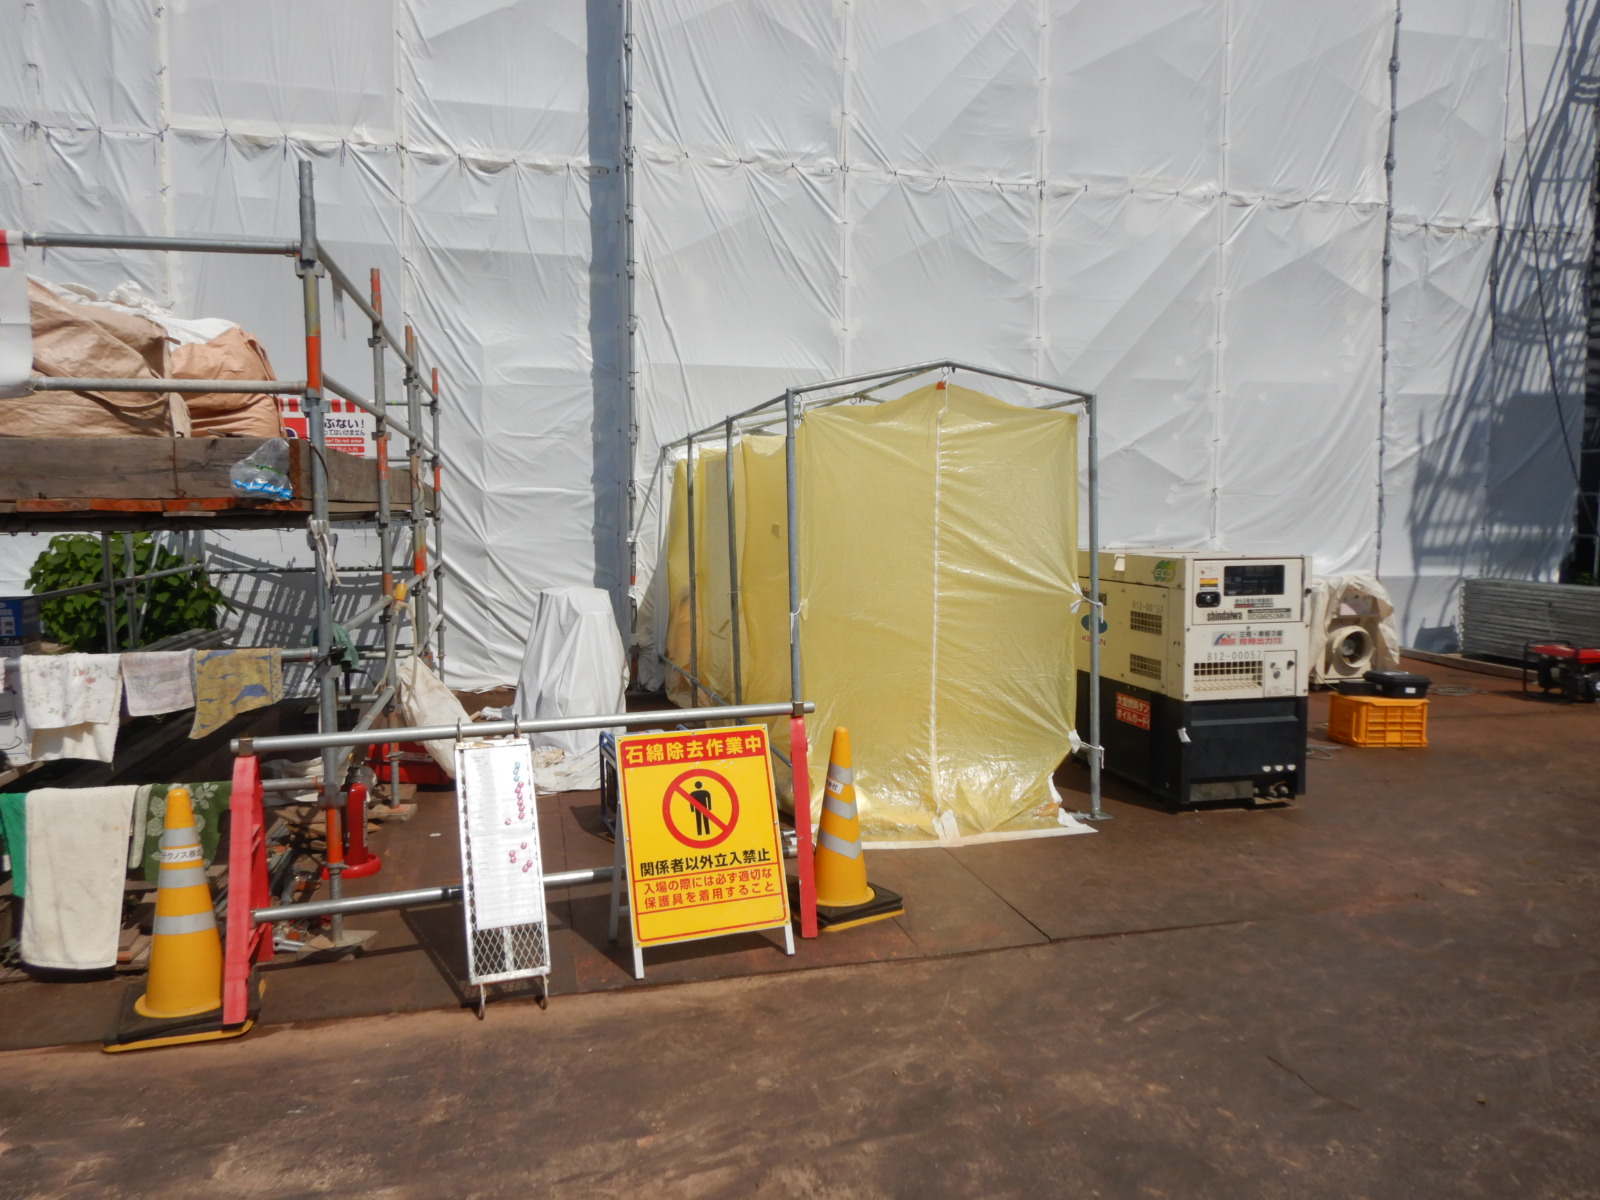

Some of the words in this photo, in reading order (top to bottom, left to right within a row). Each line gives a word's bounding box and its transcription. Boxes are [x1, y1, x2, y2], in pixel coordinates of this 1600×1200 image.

[1207, 610, 1243, 621] shindaiwa
[1207, 650, 1262, 661] 812-00057
[625, 735, 762, 765] 石綿除去作業中
[640, 848, 771, 877] 関係者以外立入禁止
[644, 868, 772, 895] 入場の際には必ず適切な
[644, 882, 775, 909] 保護具を着用すること
